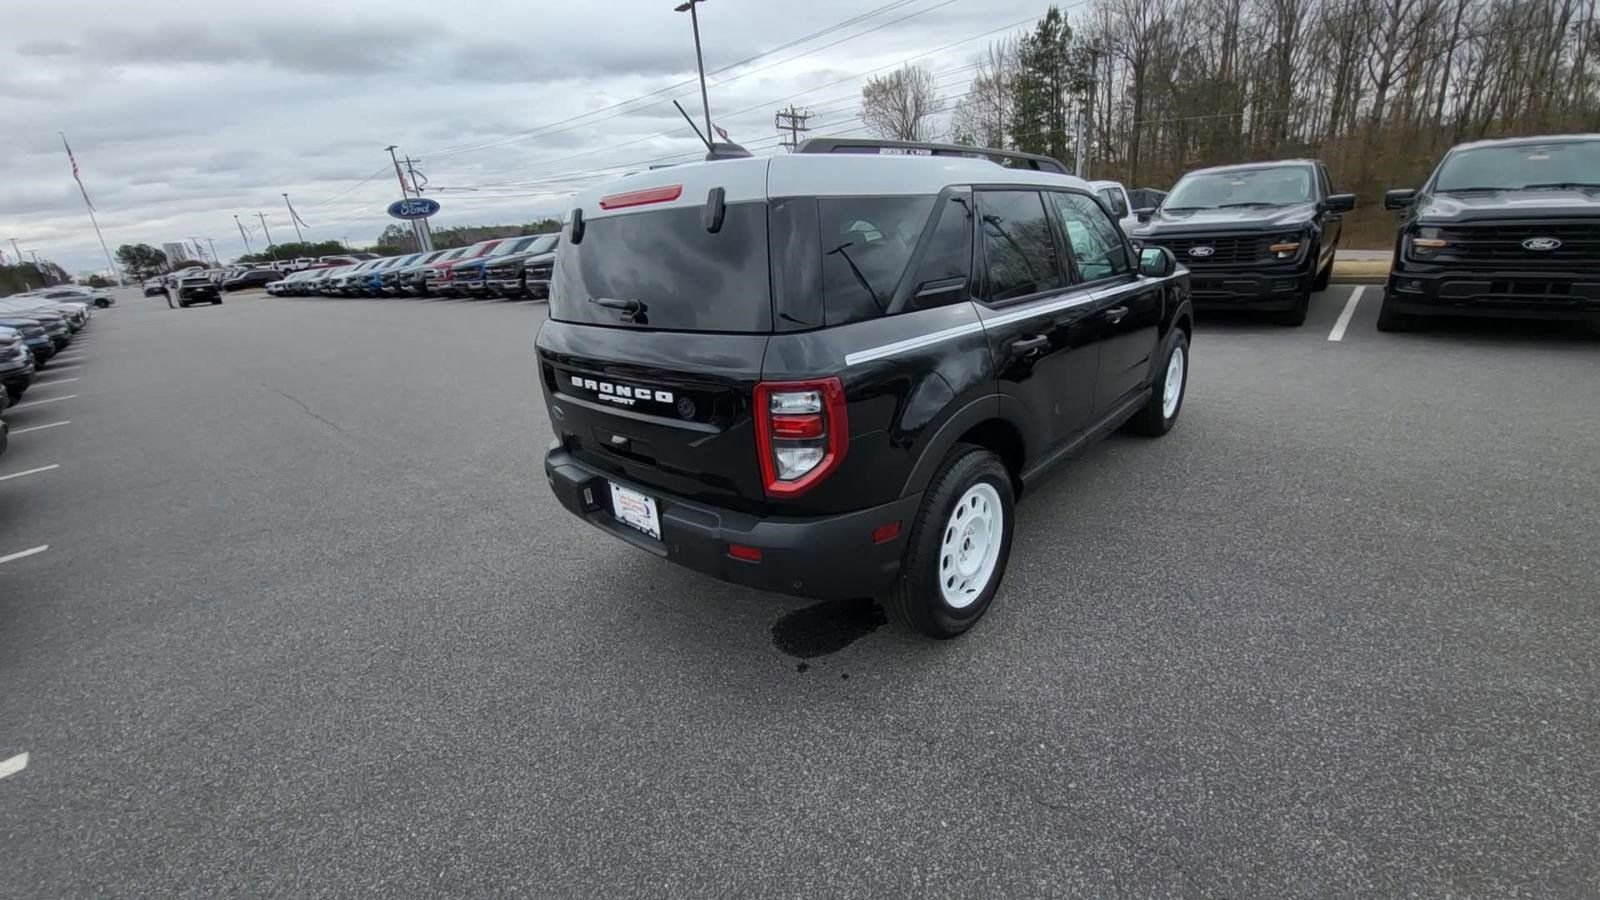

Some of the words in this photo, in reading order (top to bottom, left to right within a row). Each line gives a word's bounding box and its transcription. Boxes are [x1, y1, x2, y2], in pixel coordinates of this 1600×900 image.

[400, 201, 430, 216] Ford
[571, 376, 674, 403] BRONCO
[598, 393, 636, 406] SPORT
